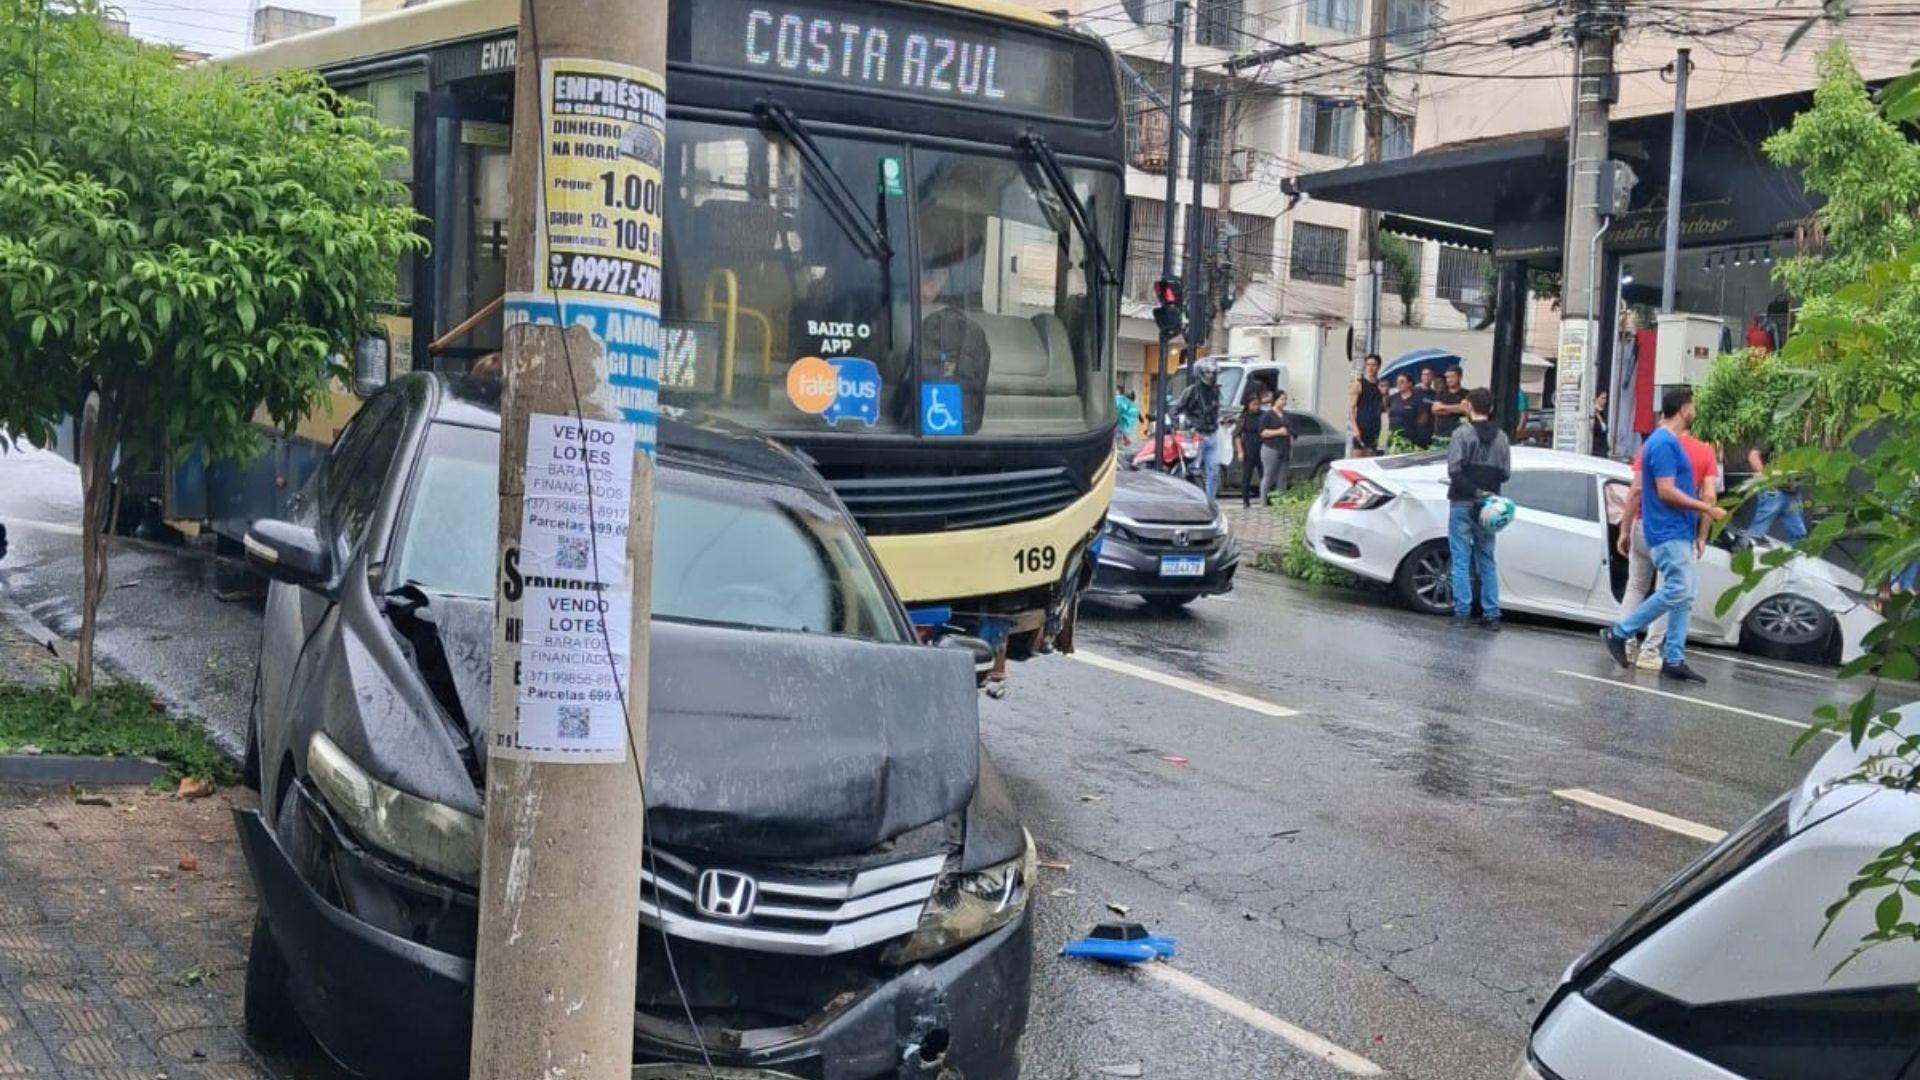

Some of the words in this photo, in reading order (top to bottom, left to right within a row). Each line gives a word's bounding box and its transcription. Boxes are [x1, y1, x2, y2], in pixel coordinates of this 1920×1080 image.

[481, 39, 518, 70] ENTR
[747, 10, 888, 82] COSTA
[902, 34, 1005, 98] AZUL
[553, 120, 621, 139] DINHEIRO
[553, 142, 570, 155] NA
[574, 142, 619, 160] HORA!
[555, 178, 592, 190] Pegue
[807, 320, 854, 337] BAIXE
[857, 323, 870, 338] O
[821, 339, 852, 353] APP
[553, 424, 615, 445] VENDO
[553, 446, 611, 465] LOTES
[529, 514, 585, 532] Parcelas
[1014, 545, 1056, 574] 169
[548, 598, 609, 613] VENDO
[550, 618, 606, 633] LOTES
[528, 686, 585, 701] Parcelas
